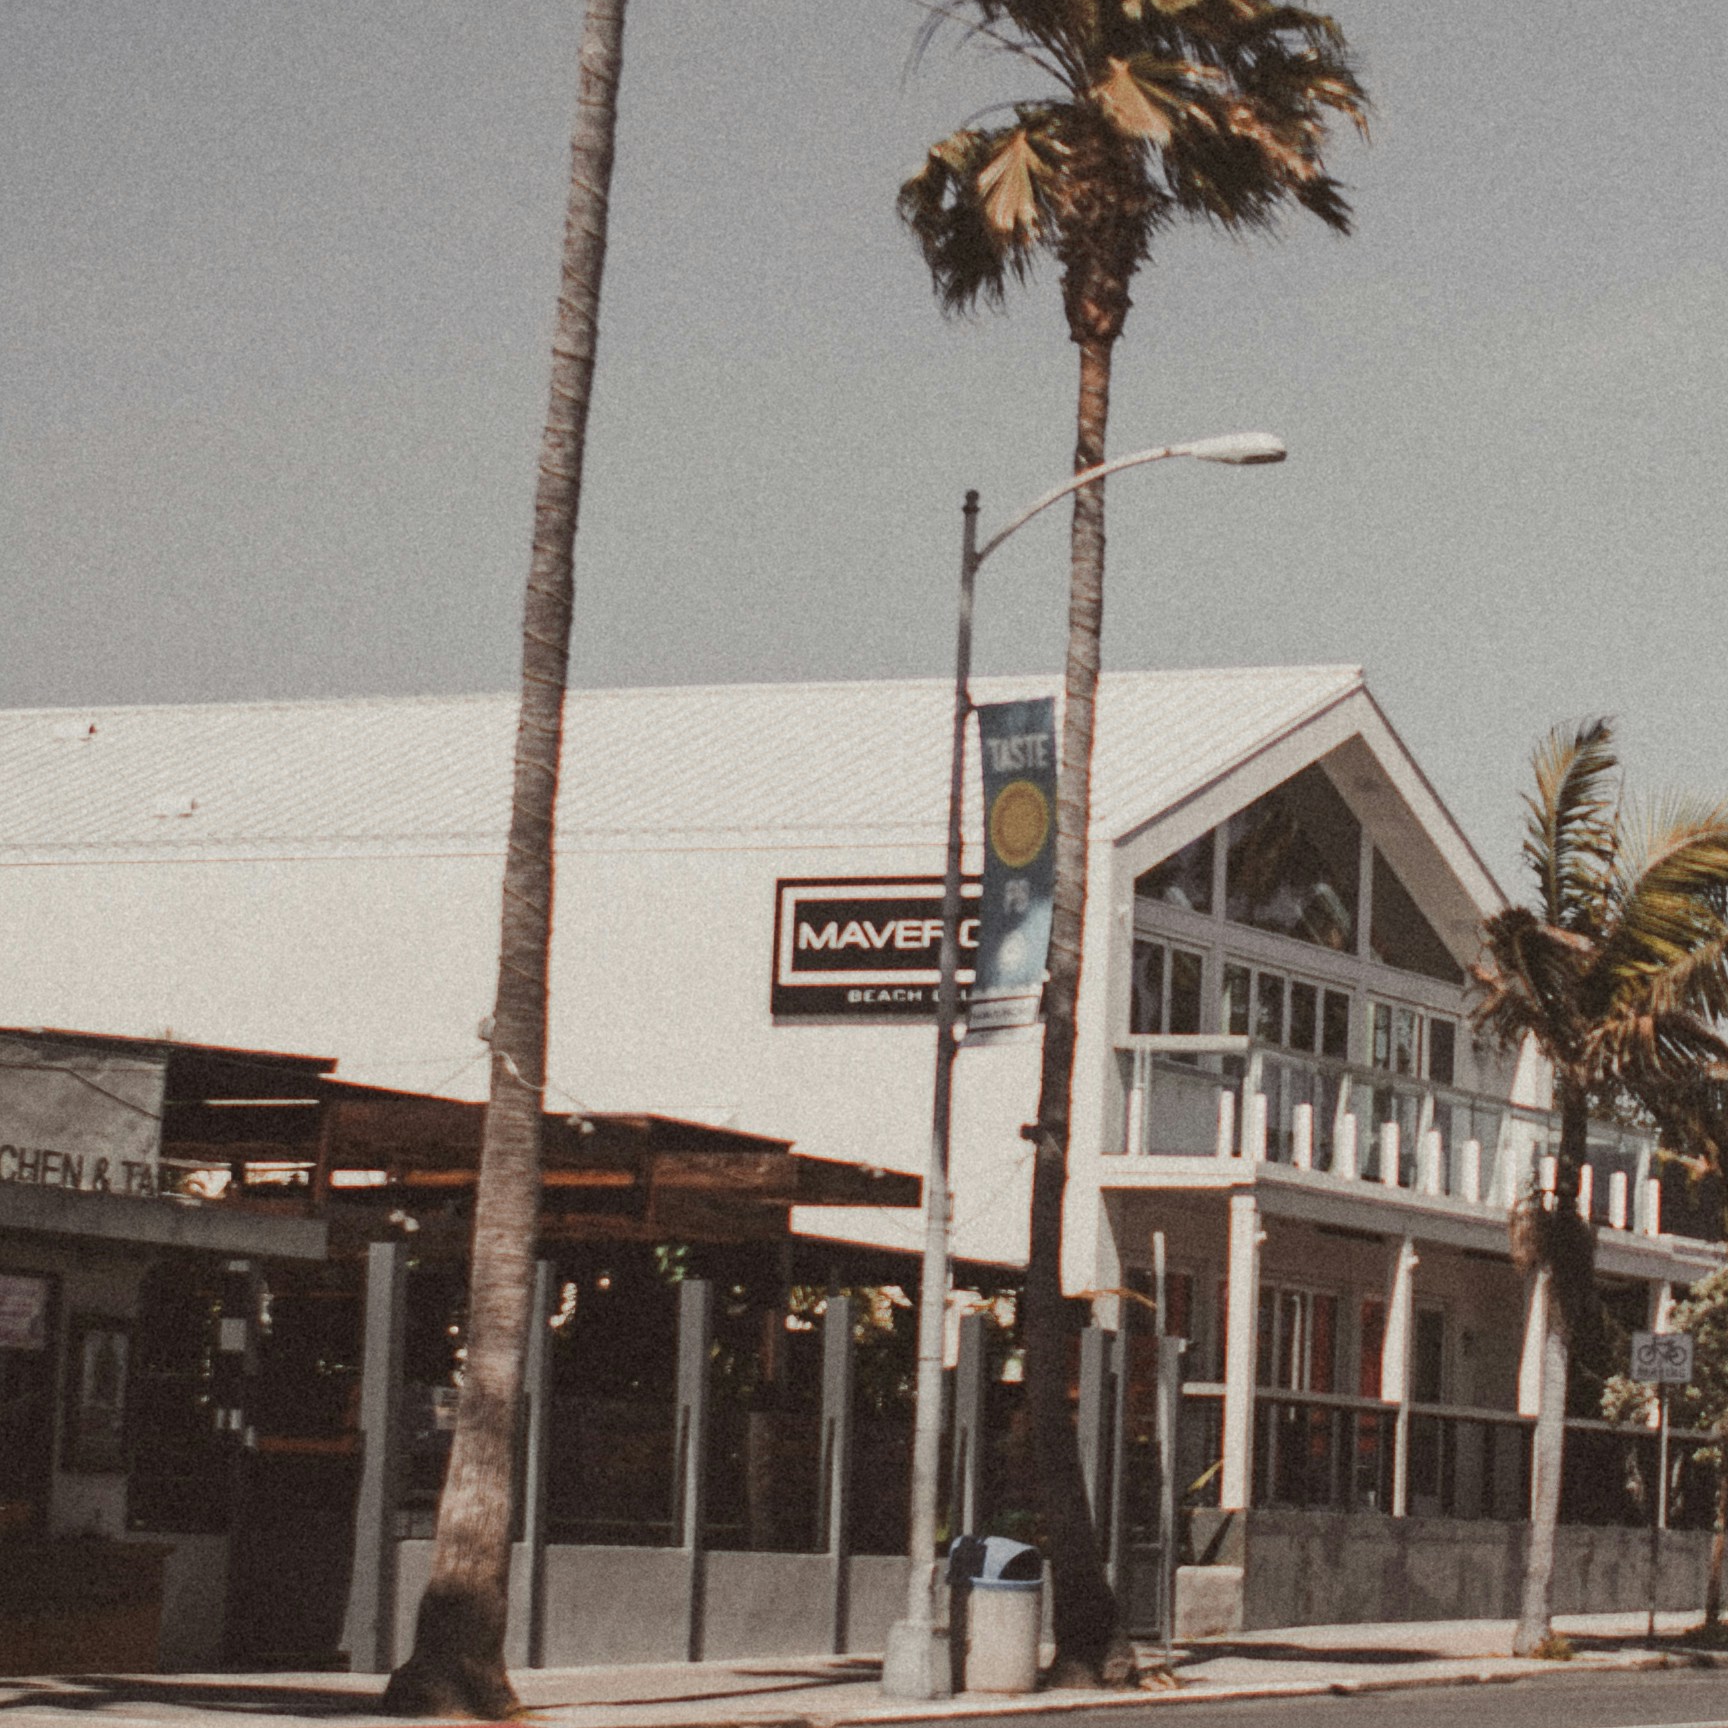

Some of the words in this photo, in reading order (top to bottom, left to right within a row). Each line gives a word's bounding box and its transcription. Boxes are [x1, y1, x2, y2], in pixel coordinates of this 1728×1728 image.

[986, 733, 1049, 772] TASTE
[798, 919, 981, 950] MAVERC
[846, 988, 923, 1003] BEACH
[0, 1144, 83, 1190] CHEN
[92, 1157, 112, 1193] &
